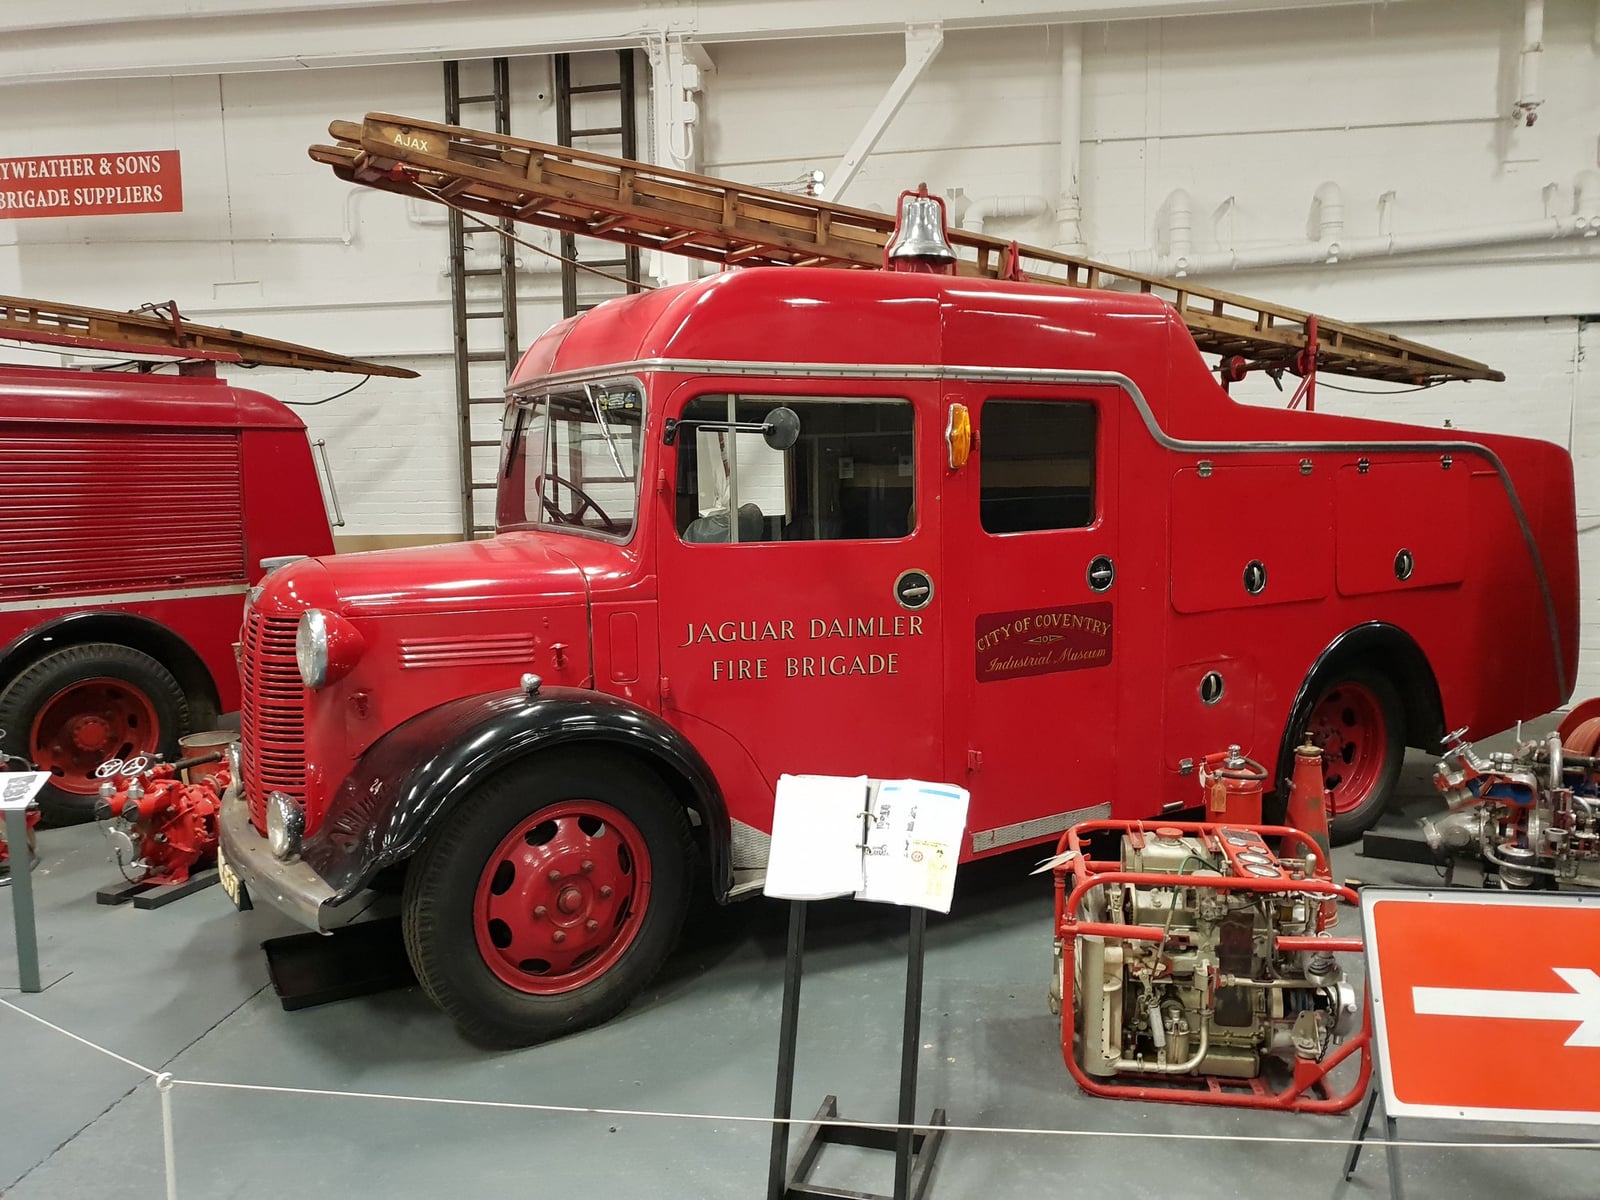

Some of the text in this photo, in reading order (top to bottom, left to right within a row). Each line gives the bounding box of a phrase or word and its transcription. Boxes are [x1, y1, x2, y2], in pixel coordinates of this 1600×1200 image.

[394, 134, 428, 152] AJAX
[0, 155, 161, 180] YWEATHER & SONS
[0, 184, 163, 210] BRIGADE SUPPLIERS
[678, 615, 924, 648] JAGUAR DAIMLER
[977, 613, 1111, 651] CITY OF COVENTRY
[712, 653, 899, 681] FIRE BRIGADE
[985, 647, 1107, 672] Industrial Museum
